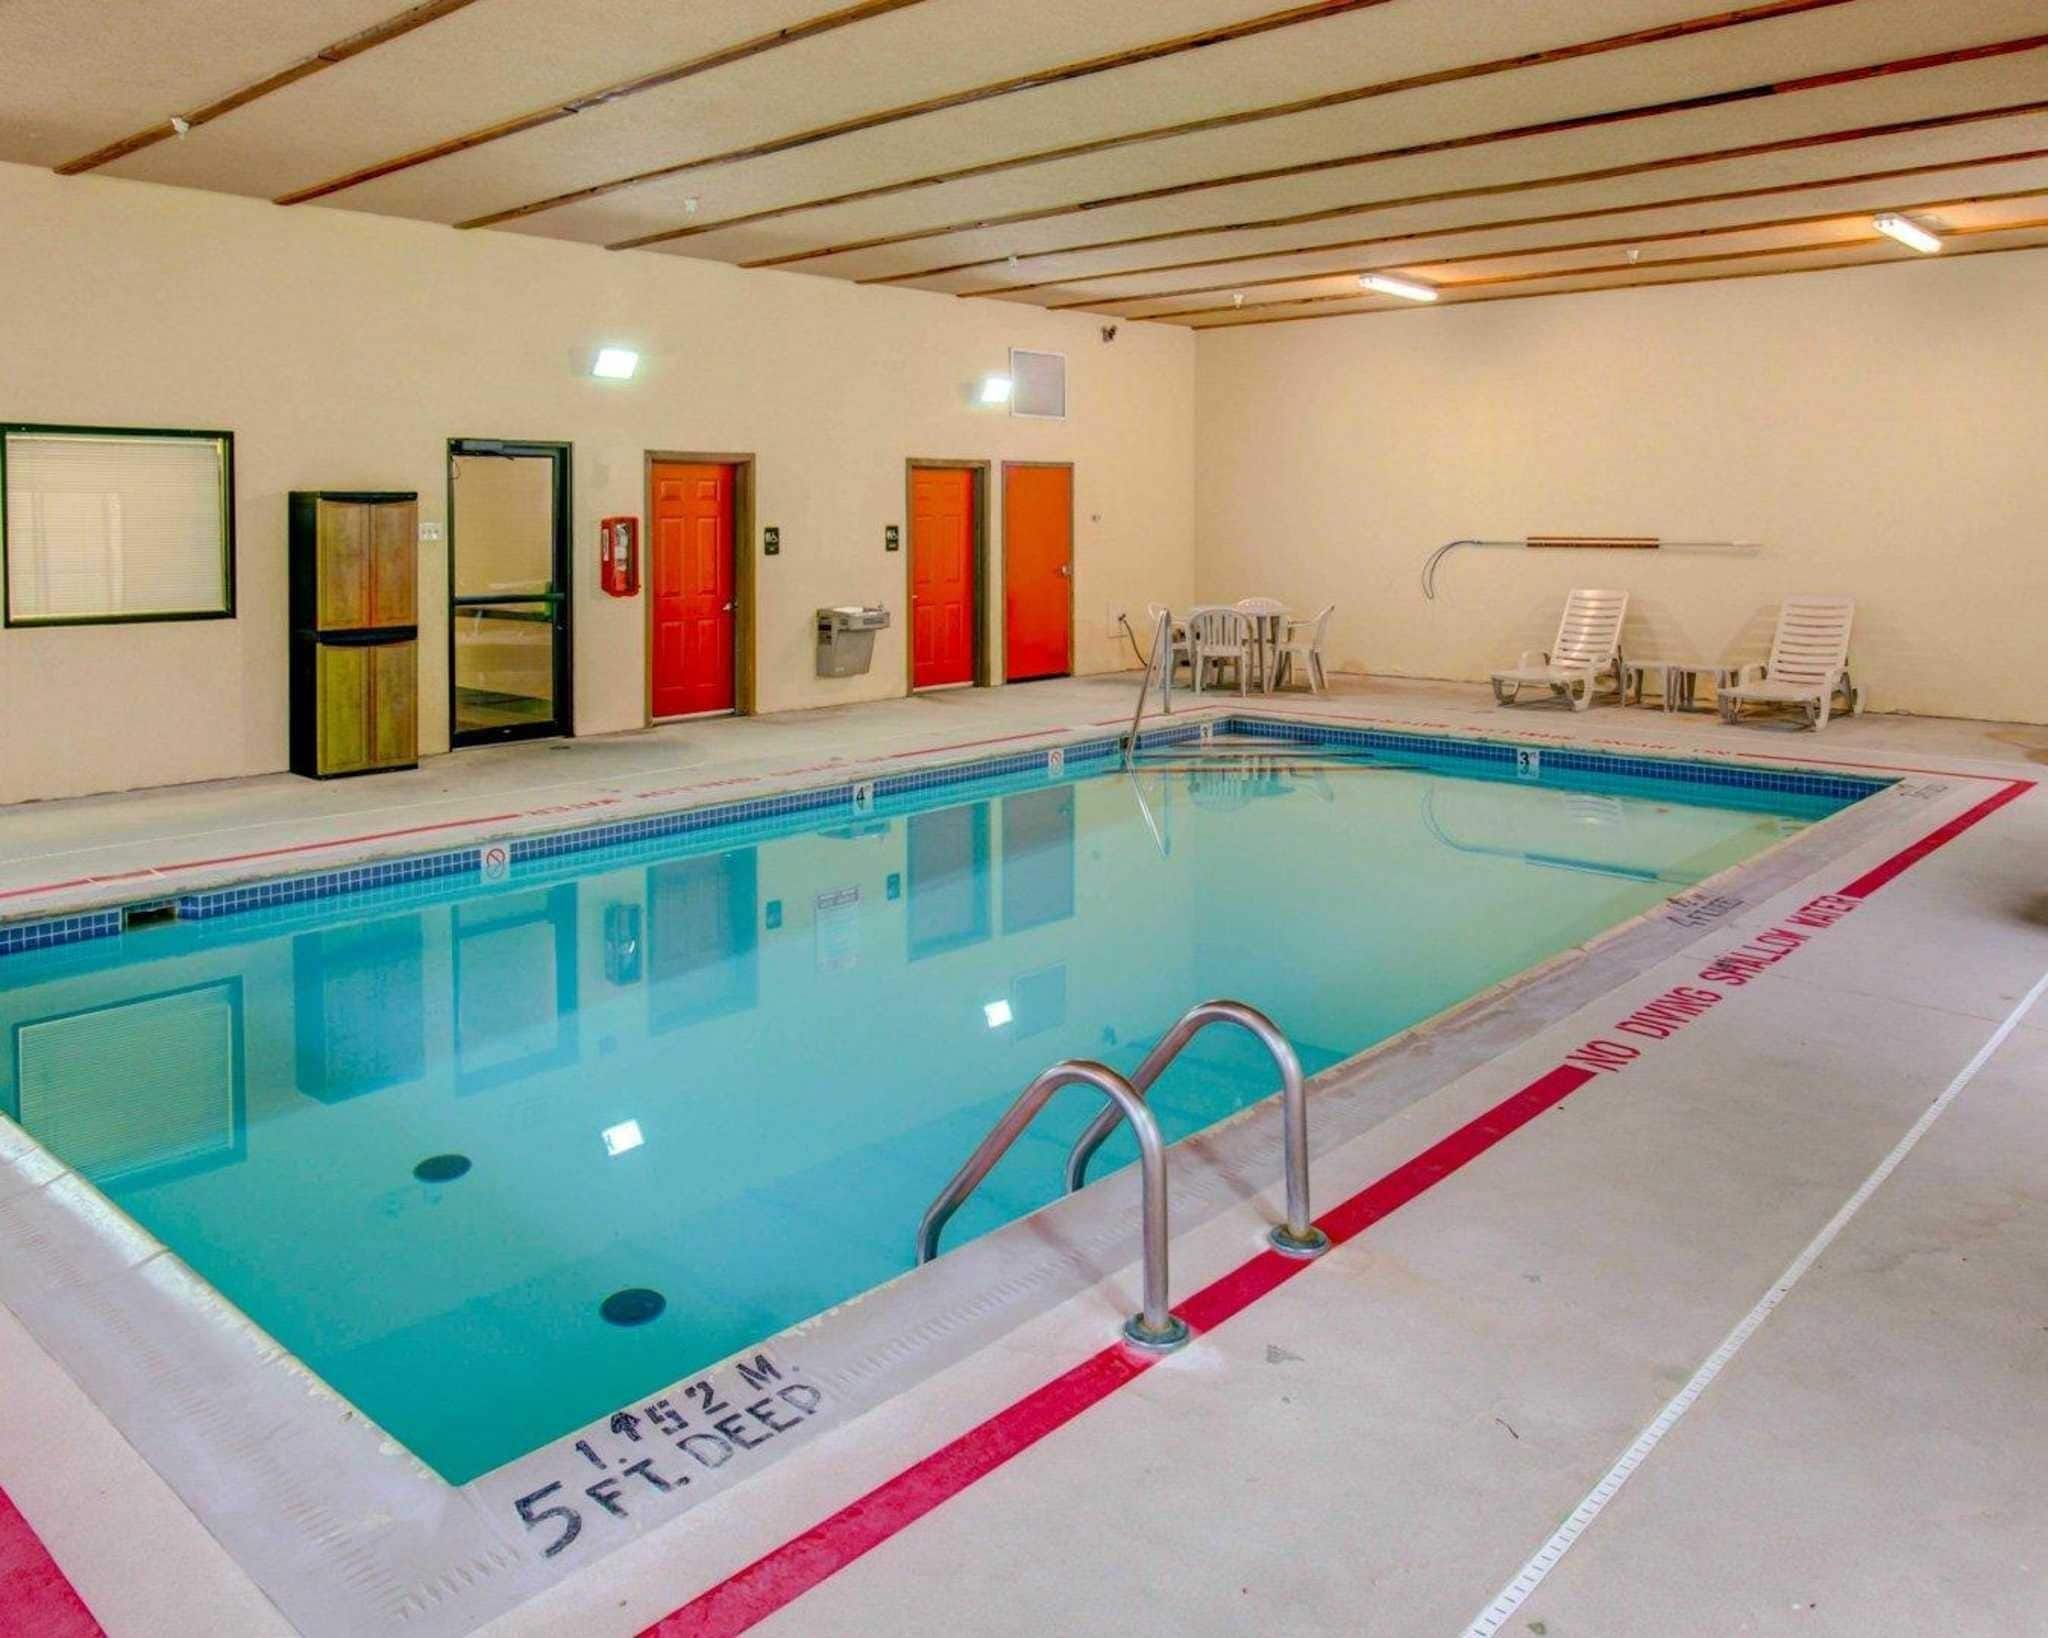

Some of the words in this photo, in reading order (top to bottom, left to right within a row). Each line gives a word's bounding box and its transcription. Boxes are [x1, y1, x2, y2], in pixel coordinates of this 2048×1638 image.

[1519, 751, 1530, 767] 3
[1565, 1039, 1641, 1073] NO
[1614, 986, 1723, 1040] DIVING
[1697, 927, 1812, 986] SHALLOW
[1784, 893, 1864, 929] WATER
[514, 1480, 583, 1559] 5
